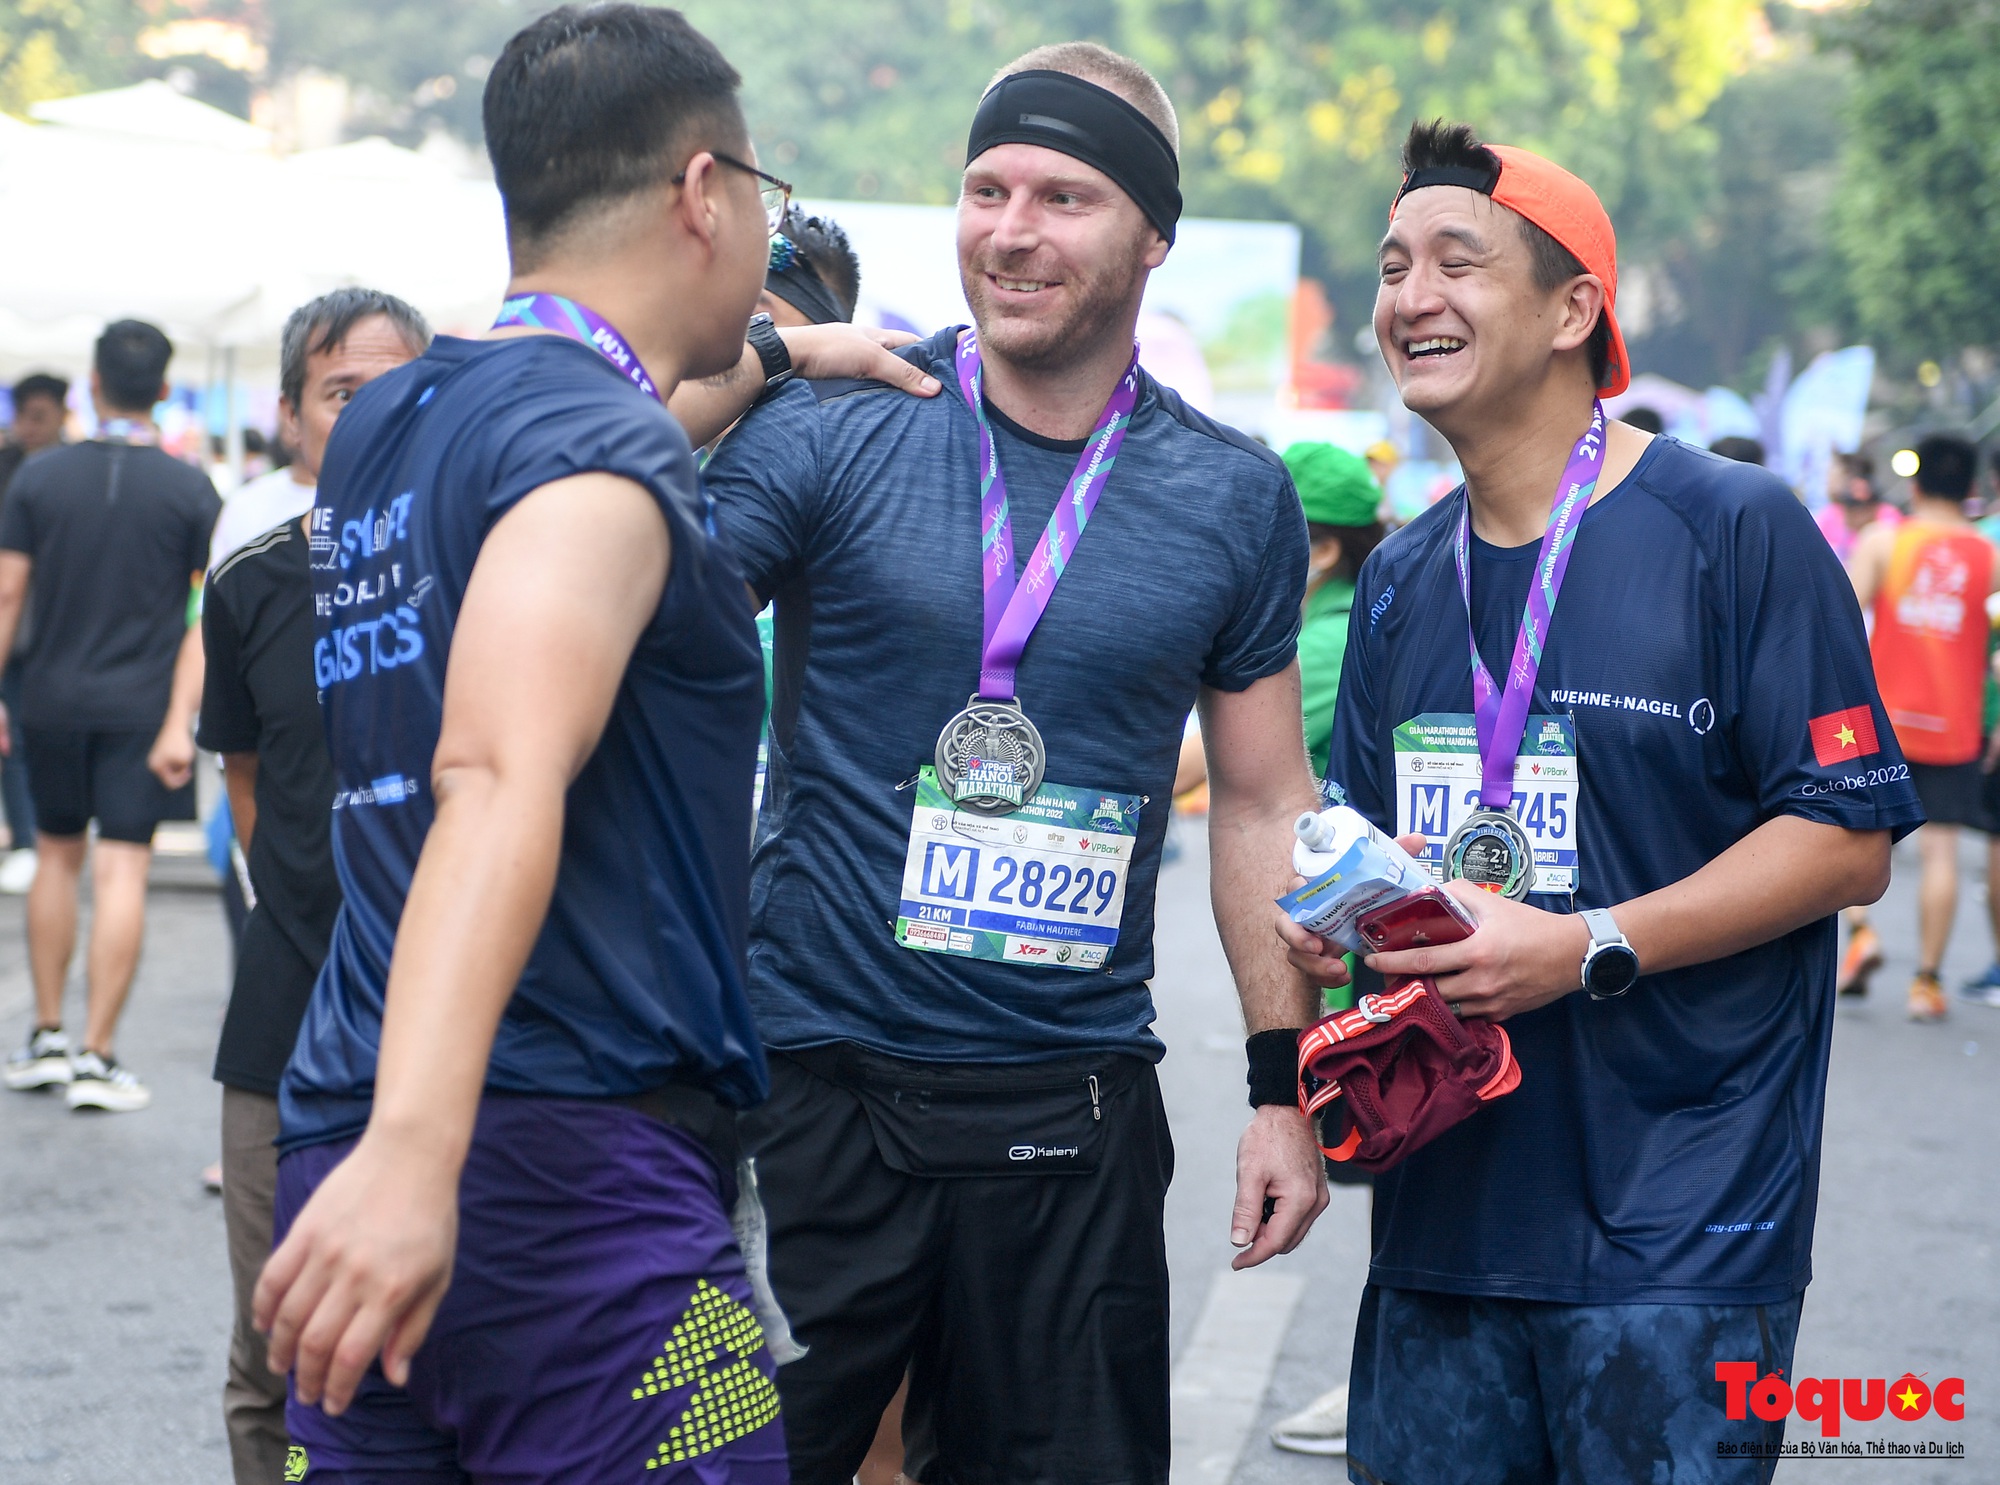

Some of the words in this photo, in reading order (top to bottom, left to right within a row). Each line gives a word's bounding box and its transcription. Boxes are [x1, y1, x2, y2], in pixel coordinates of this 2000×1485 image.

[592, 327, 630, 367] KM
[1071, 471, 1096, 506] VPBANK
[1086, 450, 1104, 475] HANOI
[1097, 410, 1121, 454] MARATHON
[1579, 433, 1601, 462] 21
[1558, 482, 1581, 527] MARATHON
[1551, 525, 1566, 553] HANOI
[1541, 551, 1561, 590] VPBANK
[315, 593, 332, 616] HE
[1551, 689, 1682, 719] KUEHNE+NAGEL
[1421, 736, 1446, 746] VPBANK
[1446, 737, 1467, 747] HANOI
[1424, 726, 1459, 736] MARATHON
[969, 769, 1013, 783] HANOI
[1542, 766, 1568, 776] VPBank
[1867, 763, 1911, 786] 2022
[957, 780, 1022, 804] MARATHON
[1046, 808, 1064, 819] 2022
[1415, 786, 1444, 834] M
[1476, 828, 1507, 840] FINISHER
[1091, 842, 1121, 855] VPBank
[1489, 848, 1509, 864] 21
[928, 845, 971, 899] M
[988, 855, 1118, 918] 28229
[918, 905, 932, 919] 21
[933, 908, 952, 922] KM
[1046, 924, 1083, 937] HAUTIERE
[1086, 950, 1102, 960] ACC
[1037, 1145, 1079, 1158] Kalenji
